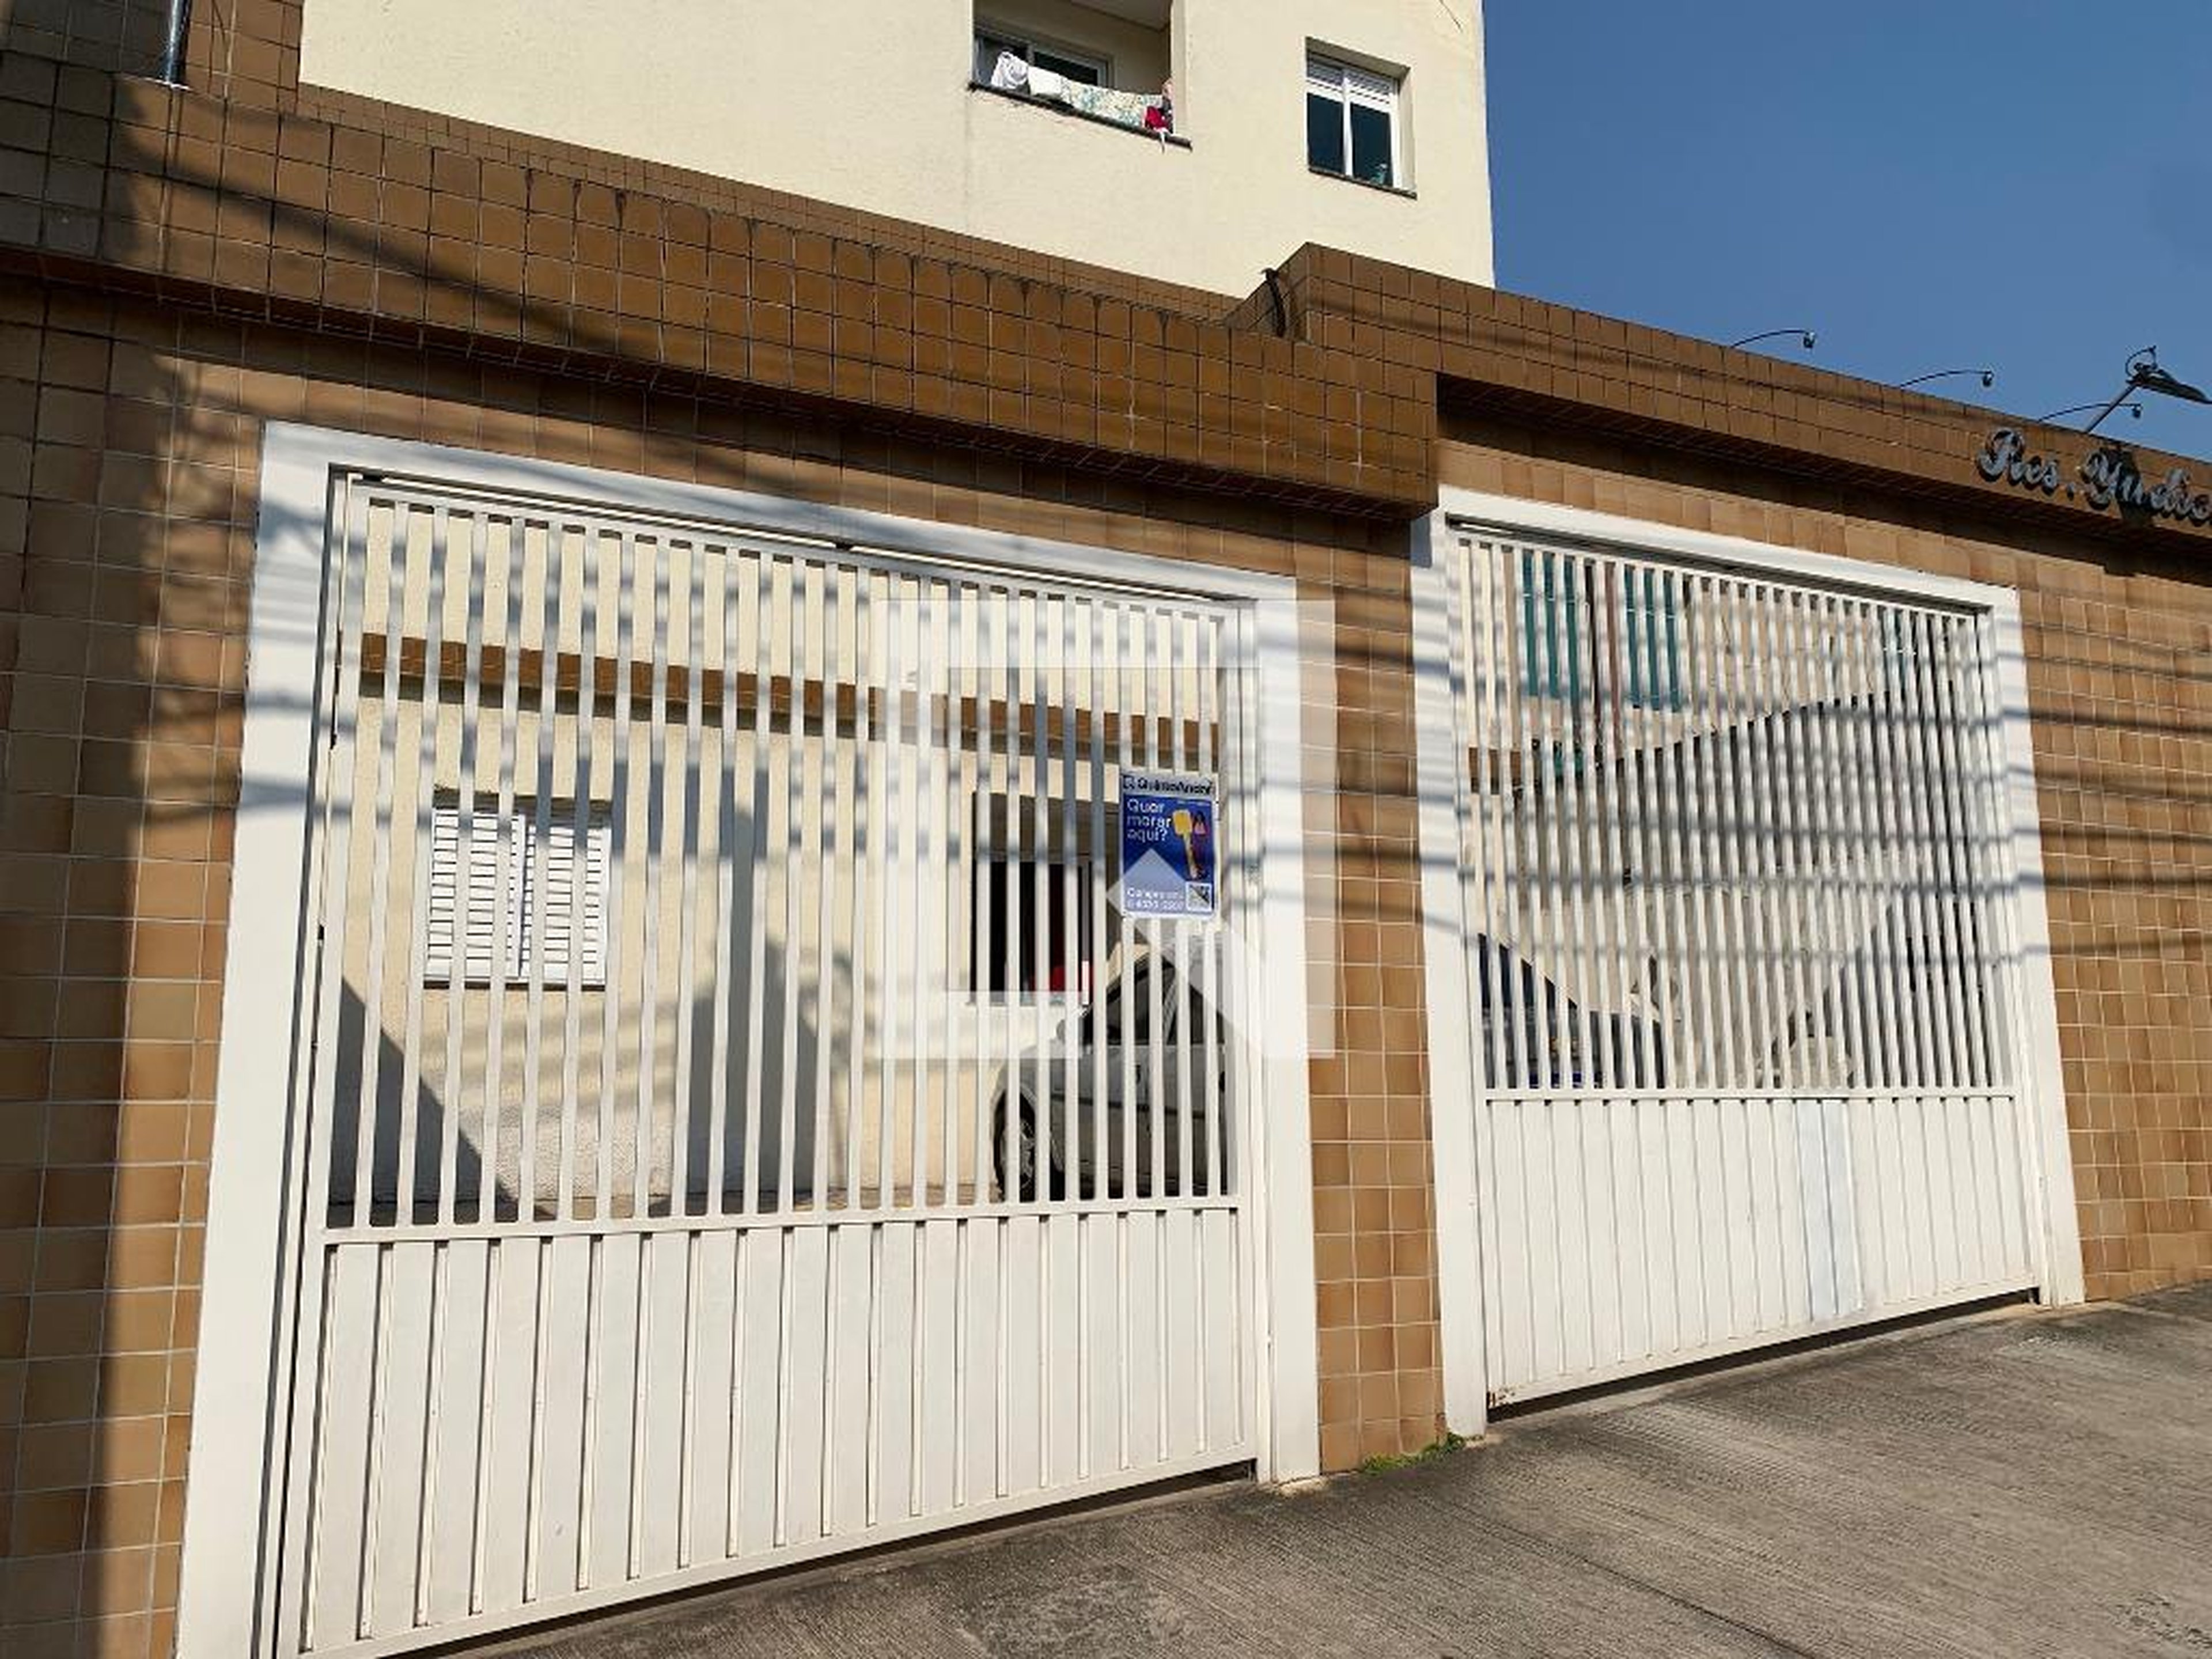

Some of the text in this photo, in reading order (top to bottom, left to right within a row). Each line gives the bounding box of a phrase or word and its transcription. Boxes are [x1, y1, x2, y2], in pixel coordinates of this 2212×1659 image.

[1127, 798, 1165, 813] Quer
[1127, 815, 1172, 828] morar
[1127, 828, 1168, 843] aqui?
